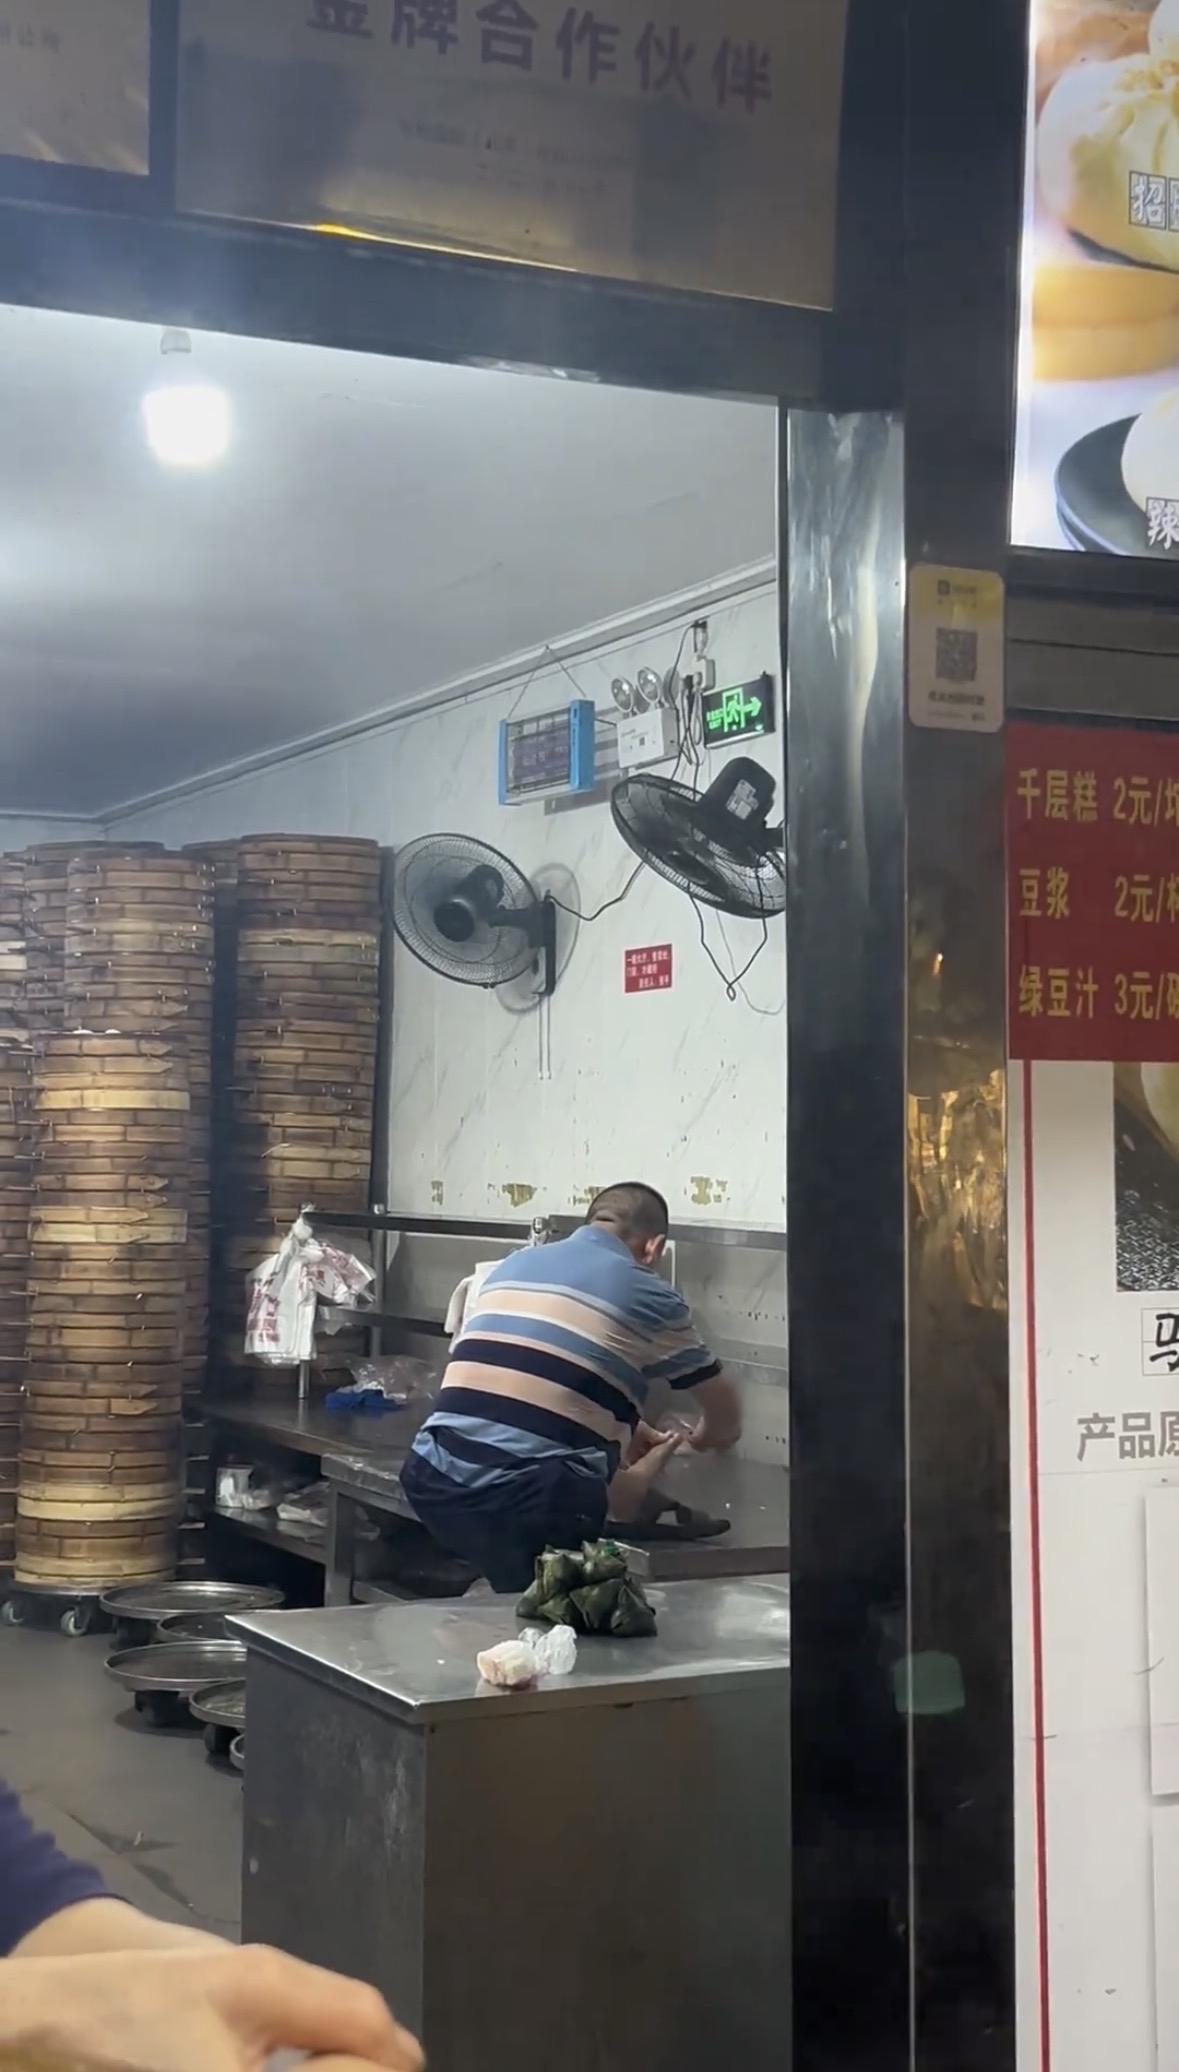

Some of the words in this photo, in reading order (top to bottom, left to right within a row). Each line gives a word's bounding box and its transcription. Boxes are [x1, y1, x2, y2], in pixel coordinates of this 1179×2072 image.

[1131, 173, 1179, 229] 招
[1017, 767, 1098, 822] 千层糕
[1019, 866, 1070, 919] 豆浆
[1019, 964, 1099, 1019] 绿豆汁
